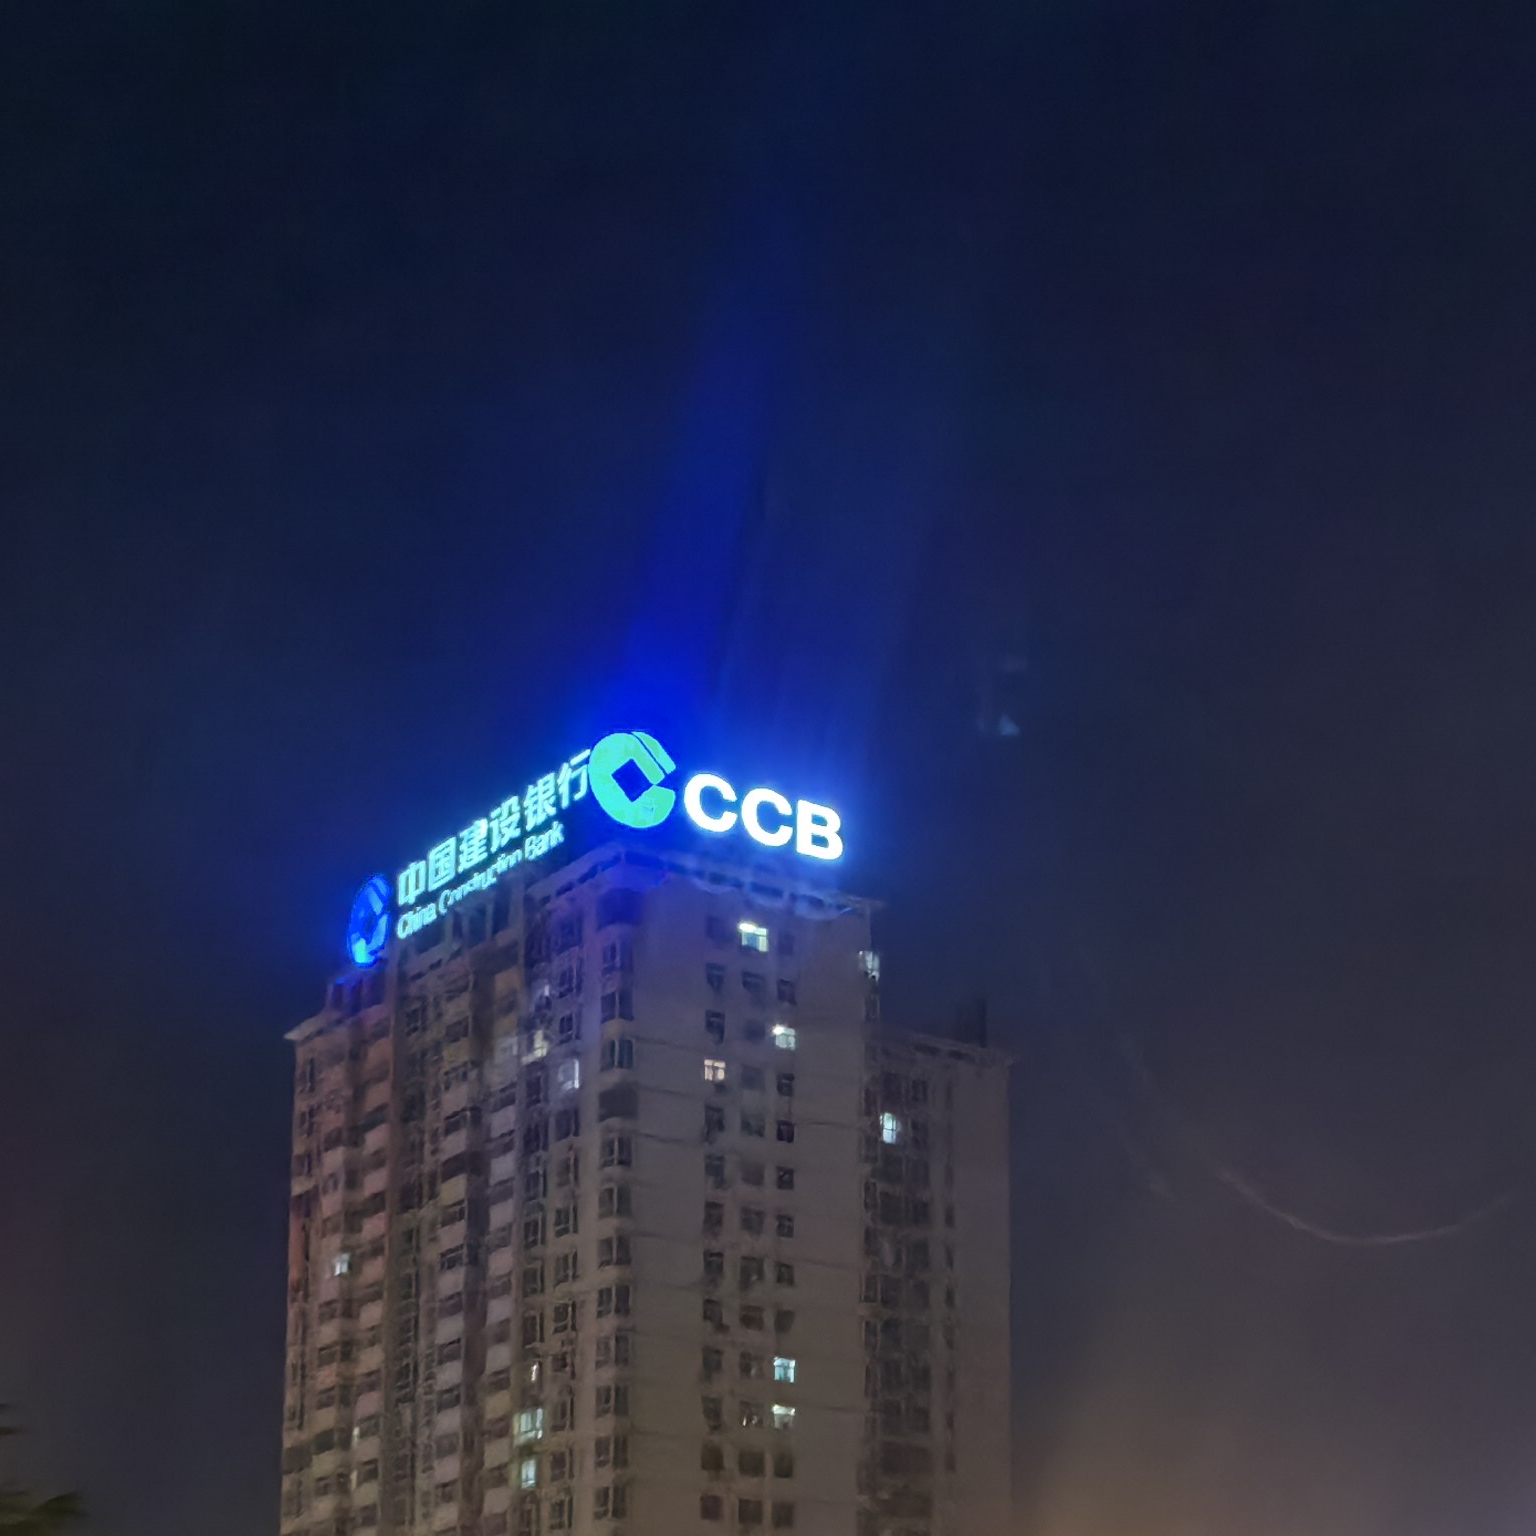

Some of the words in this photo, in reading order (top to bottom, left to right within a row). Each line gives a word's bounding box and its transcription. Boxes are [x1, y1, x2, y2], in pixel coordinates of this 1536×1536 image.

[397, 748, 591, 907] 中国建设银行
[684, 773, 844, 860] CCB
[396, 901, 437, 939] China
[438, 850, 523, 915] Construction
[524, 820, 565, 861] Bank
